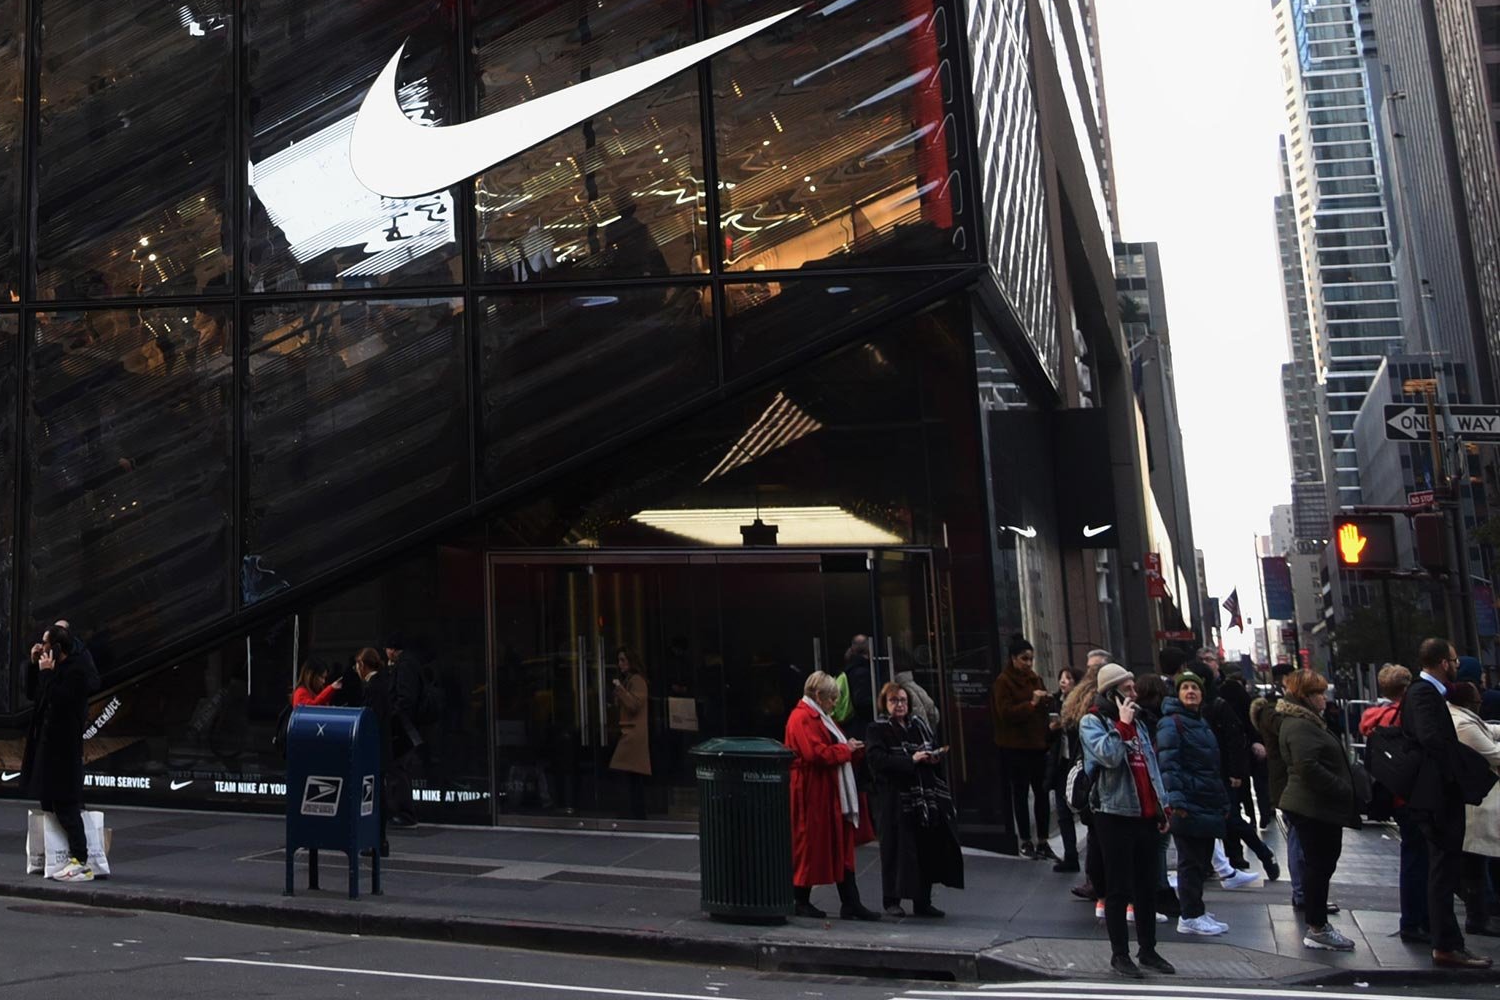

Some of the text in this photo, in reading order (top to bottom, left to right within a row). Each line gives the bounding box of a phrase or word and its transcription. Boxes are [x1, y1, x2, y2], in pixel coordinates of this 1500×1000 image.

[1457, 416, 1496, 431] WAY
[83, 775, 151, 789] AT YOUR SERVICE
[215, 781, 237, 793] TEAM
[238, 782, 257, 794] NIKE
[258, 783, 268, 794] AT
[422, 789, 441, 802] NIKE
[445, 791, 456, 802] AT
